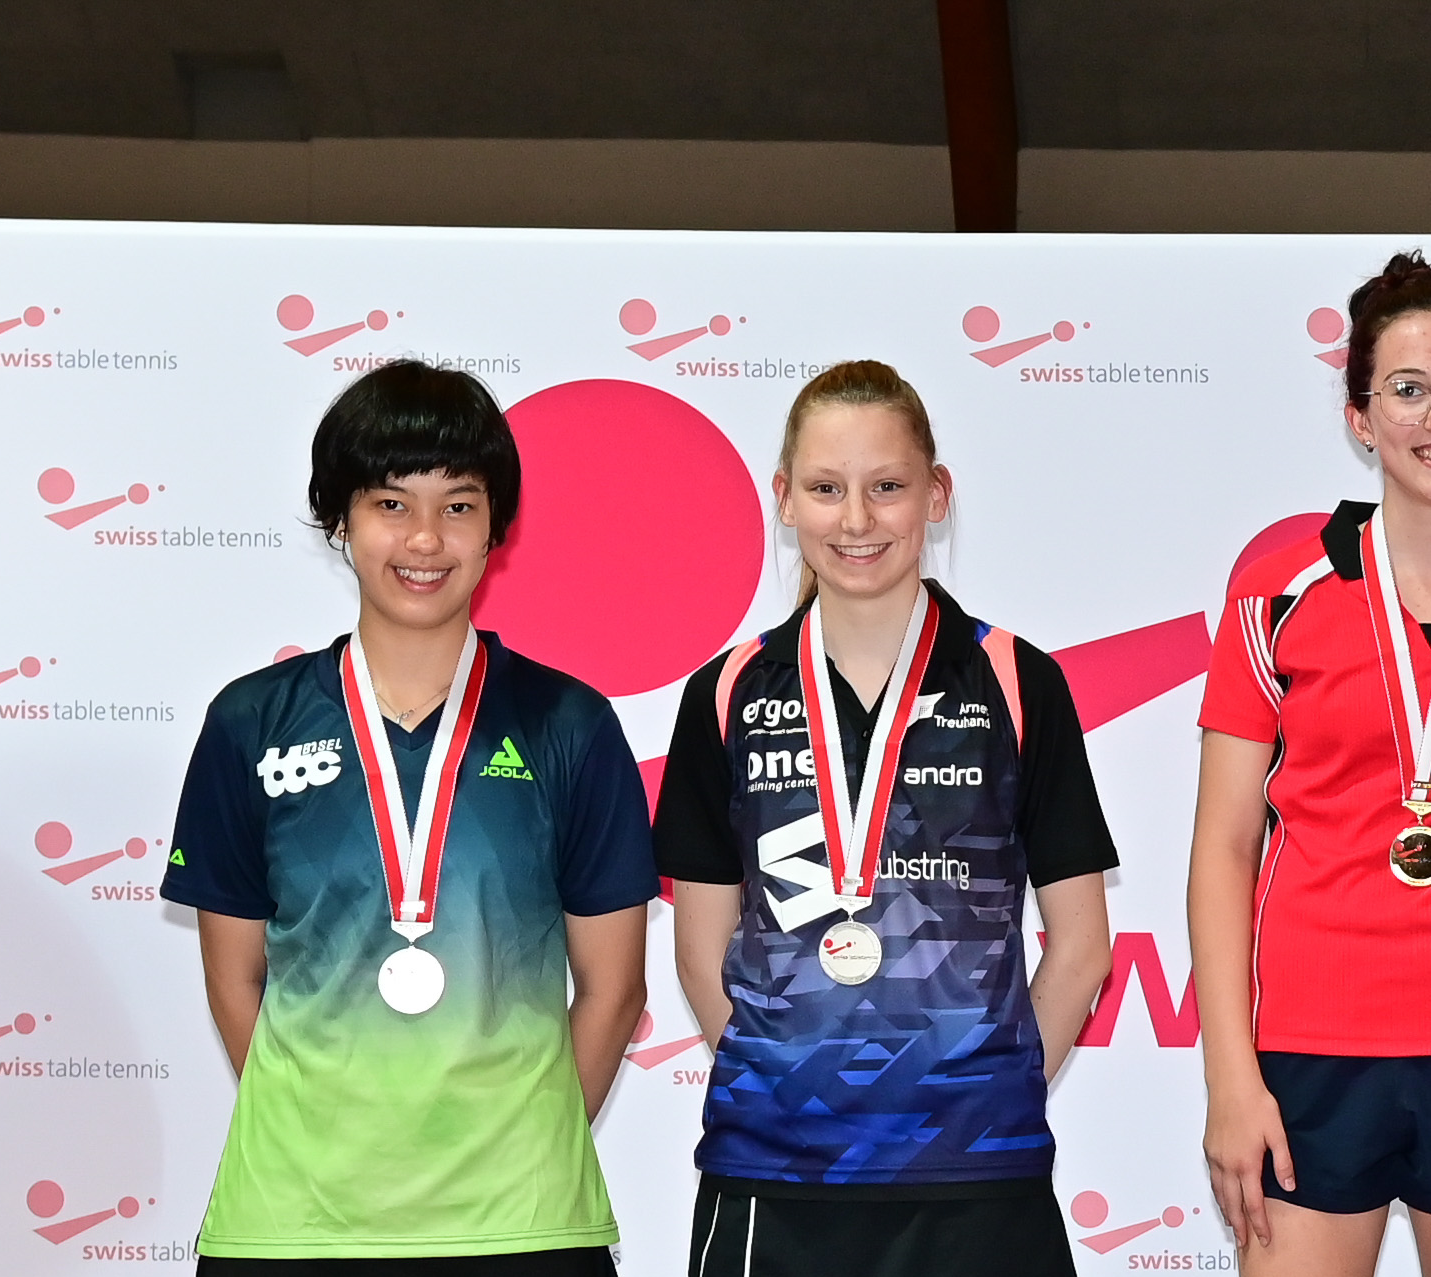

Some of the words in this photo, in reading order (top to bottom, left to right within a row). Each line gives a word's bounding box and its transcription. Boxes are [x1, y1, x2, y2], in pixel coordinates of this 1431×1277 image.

[1021, 363, 1083, 382] swiss
[479, 766, 533, 781] JOOLA
[903, 764, 983, 786] andro
